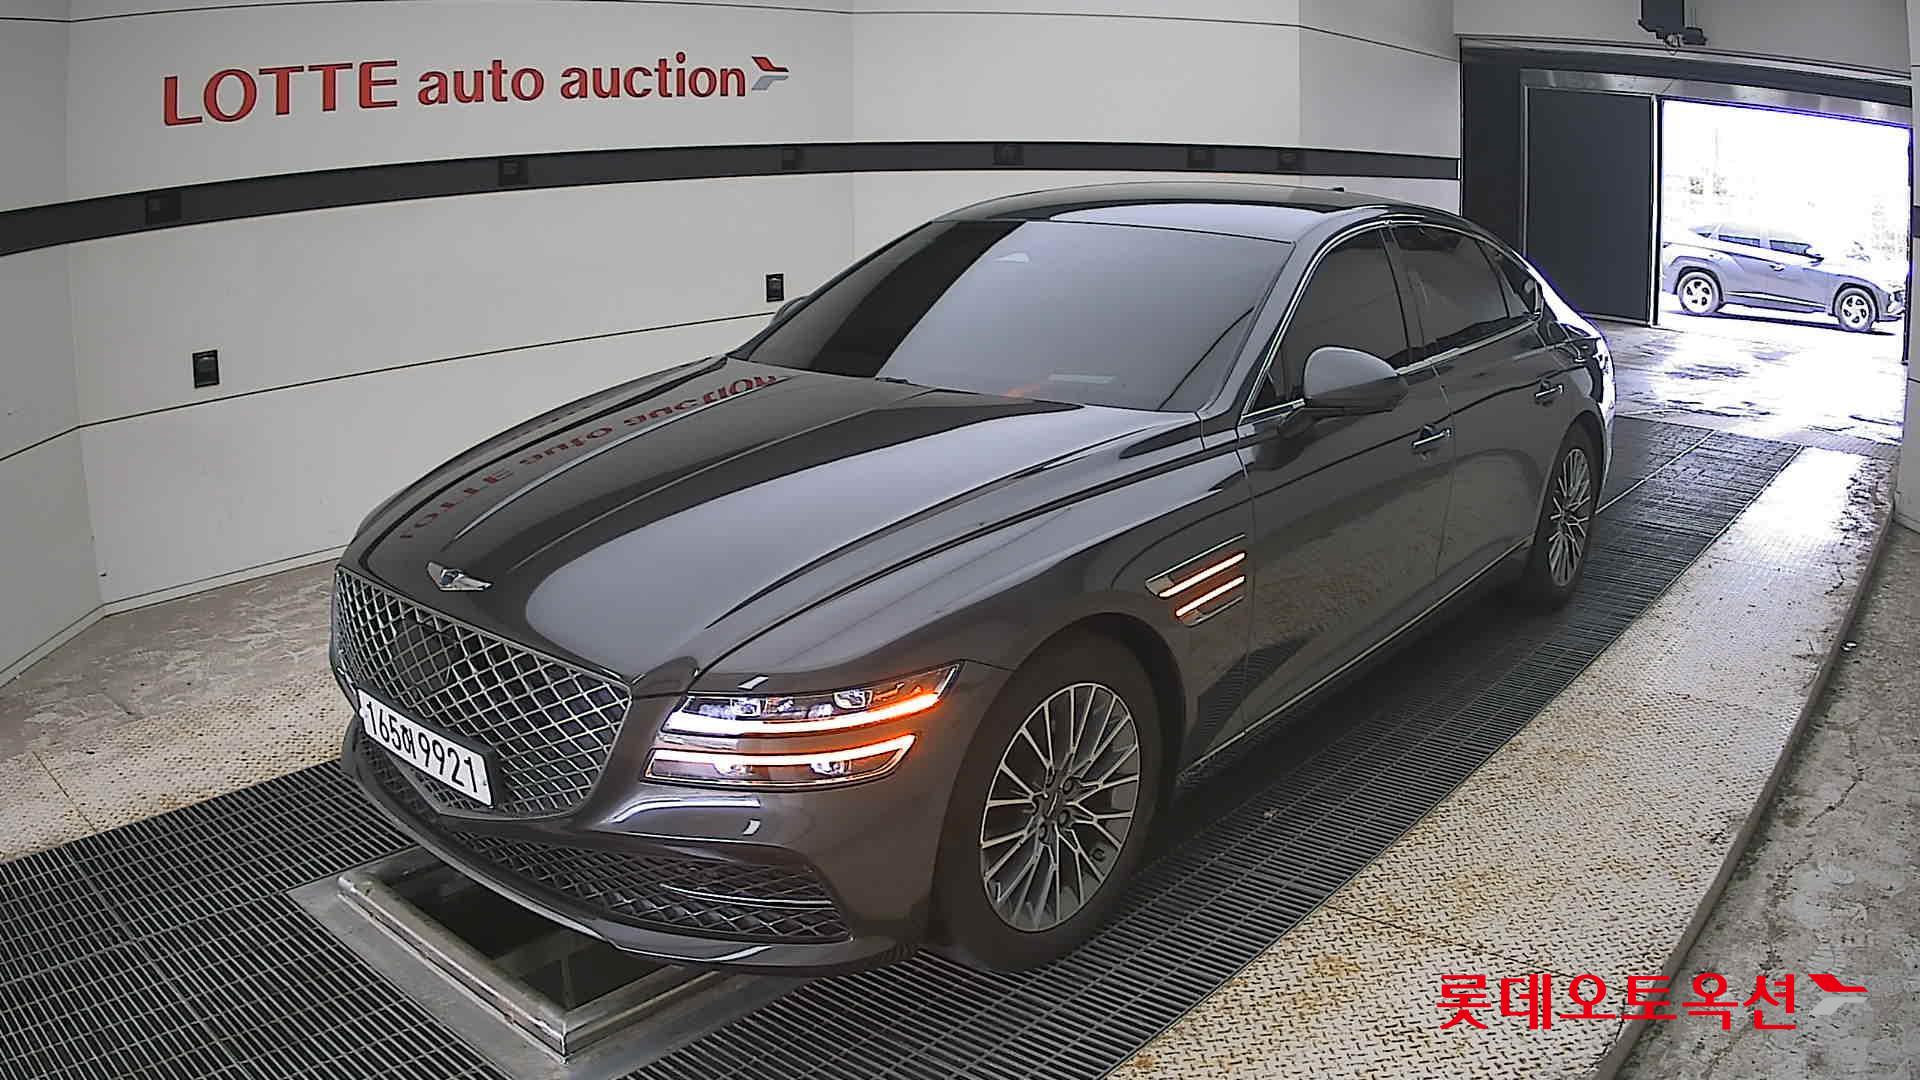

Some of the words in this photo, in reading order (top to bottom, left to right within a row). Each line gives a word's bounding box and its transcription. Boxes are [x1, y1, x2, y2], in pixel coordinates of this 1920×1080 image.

[163, 60, 399, 126] LOTTE
[418, 57, 545, 106] auto
[560, 51, 748, 99] auction
